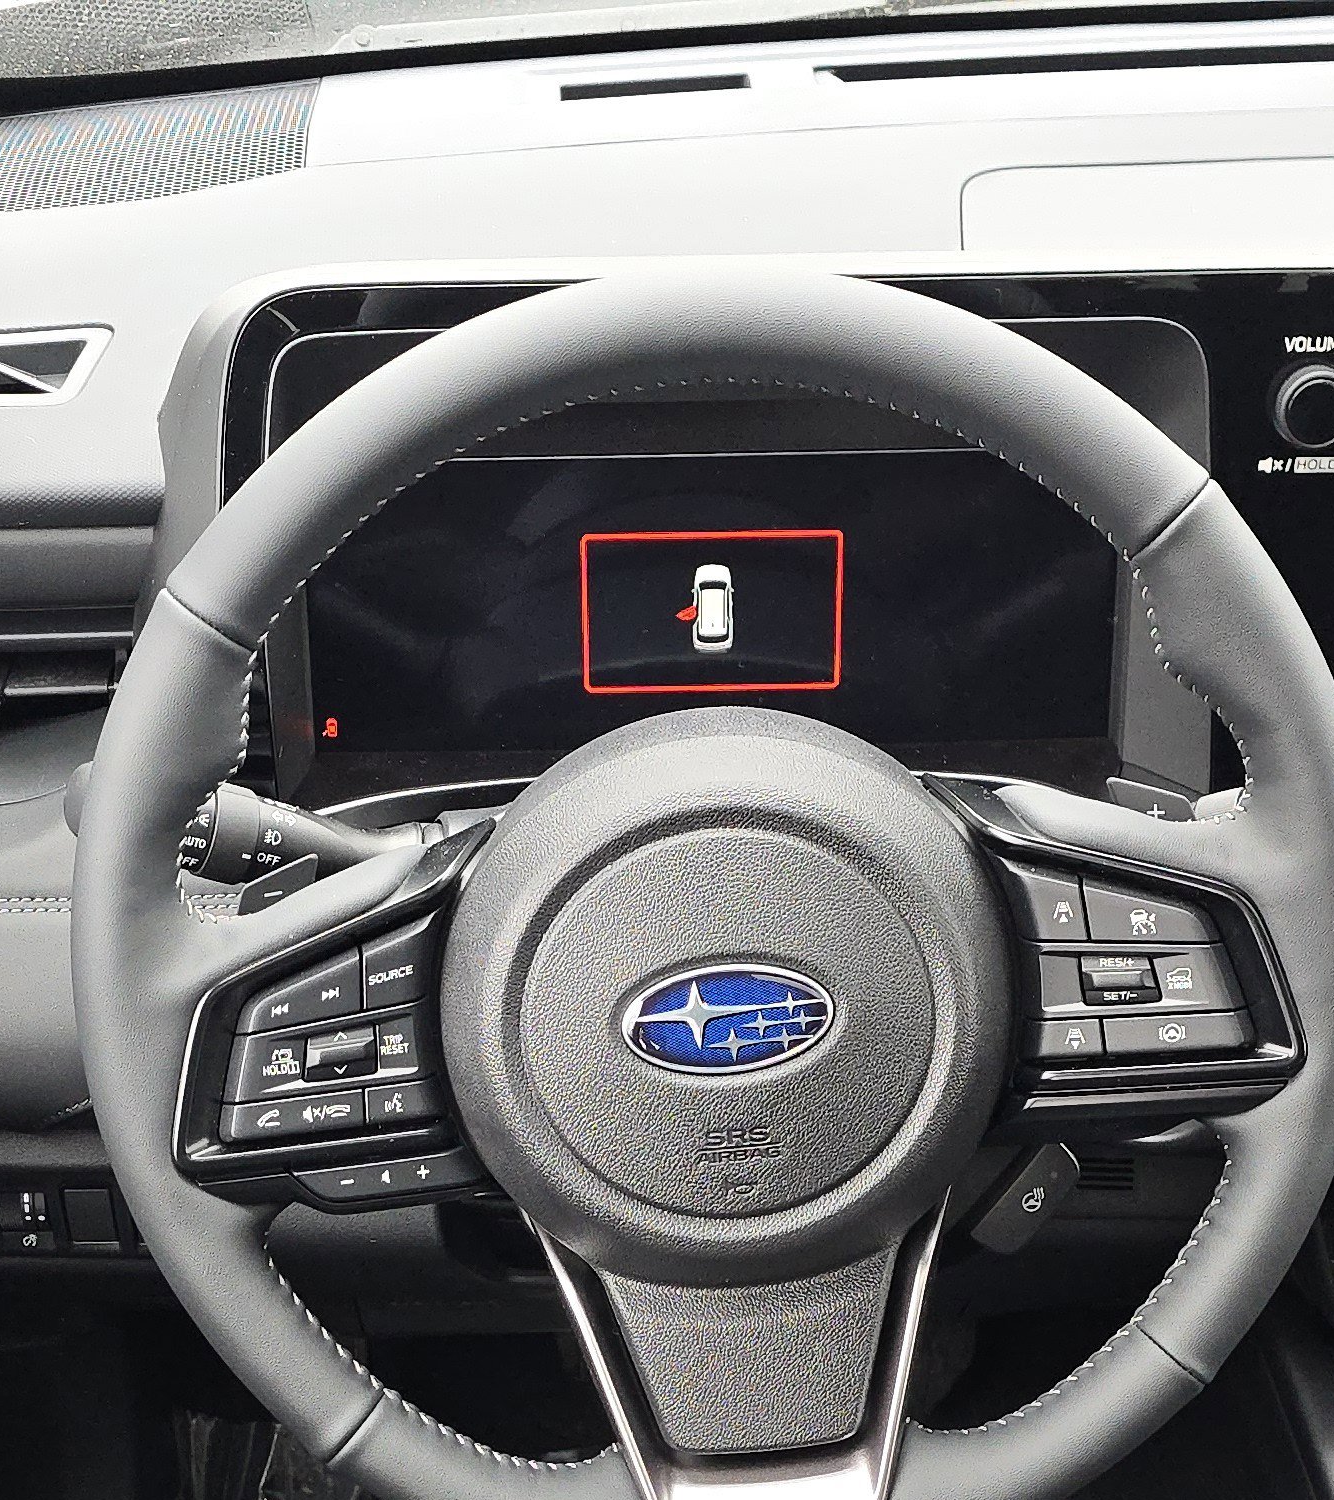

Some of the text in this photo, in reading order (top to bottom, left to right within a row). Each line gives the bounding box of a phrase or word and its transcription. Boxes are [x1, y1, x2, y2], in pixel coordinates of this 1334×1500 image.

[257, 852, 281, 866] OFF
[368, 964, 414, 986] SOURCE
[383, 1033, 403, 1046] TRIP
[380, 1043, 410, 1056] RESET
[705, 1126, 769, 1146] SRS
[699, 1149, 780, 1164] AIRBAG
